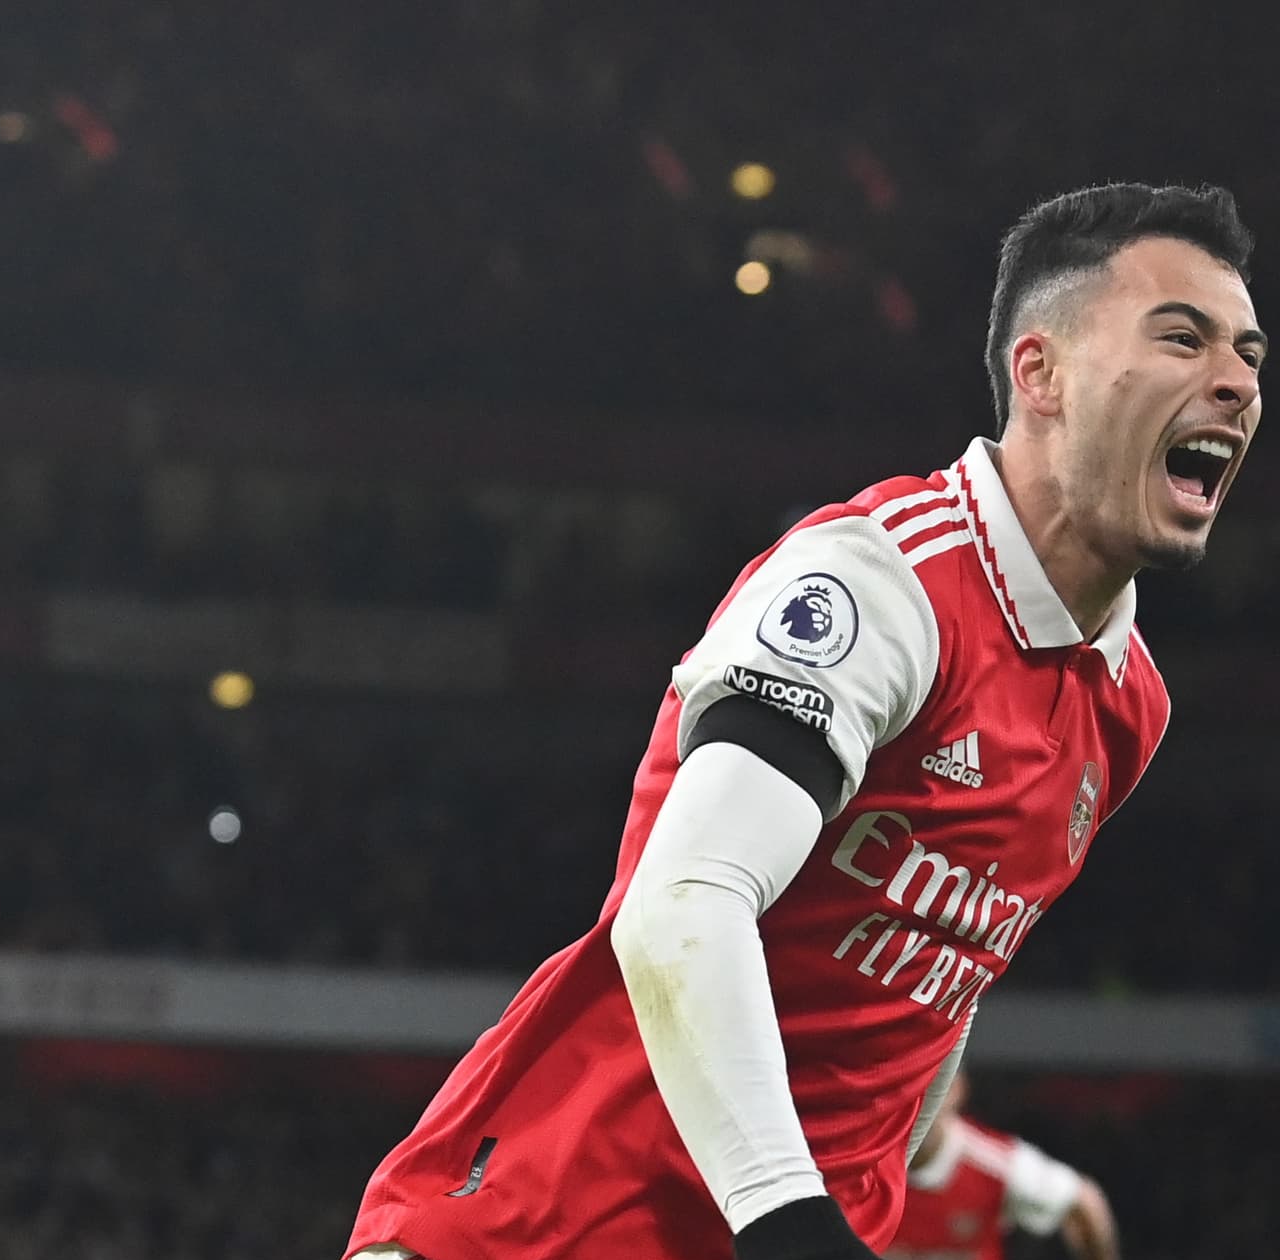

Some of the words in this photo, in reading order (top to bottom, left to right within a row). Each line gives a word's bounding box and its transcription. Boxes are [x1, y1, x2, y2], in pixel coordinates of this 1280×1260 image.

[789, 643, 822, 657] Premier
[725, 666, 758, 692] No
[761, 679, 825, 710] room
[921, 754, 984, 788] adidas
[832, 912, 930, 986] FLY
